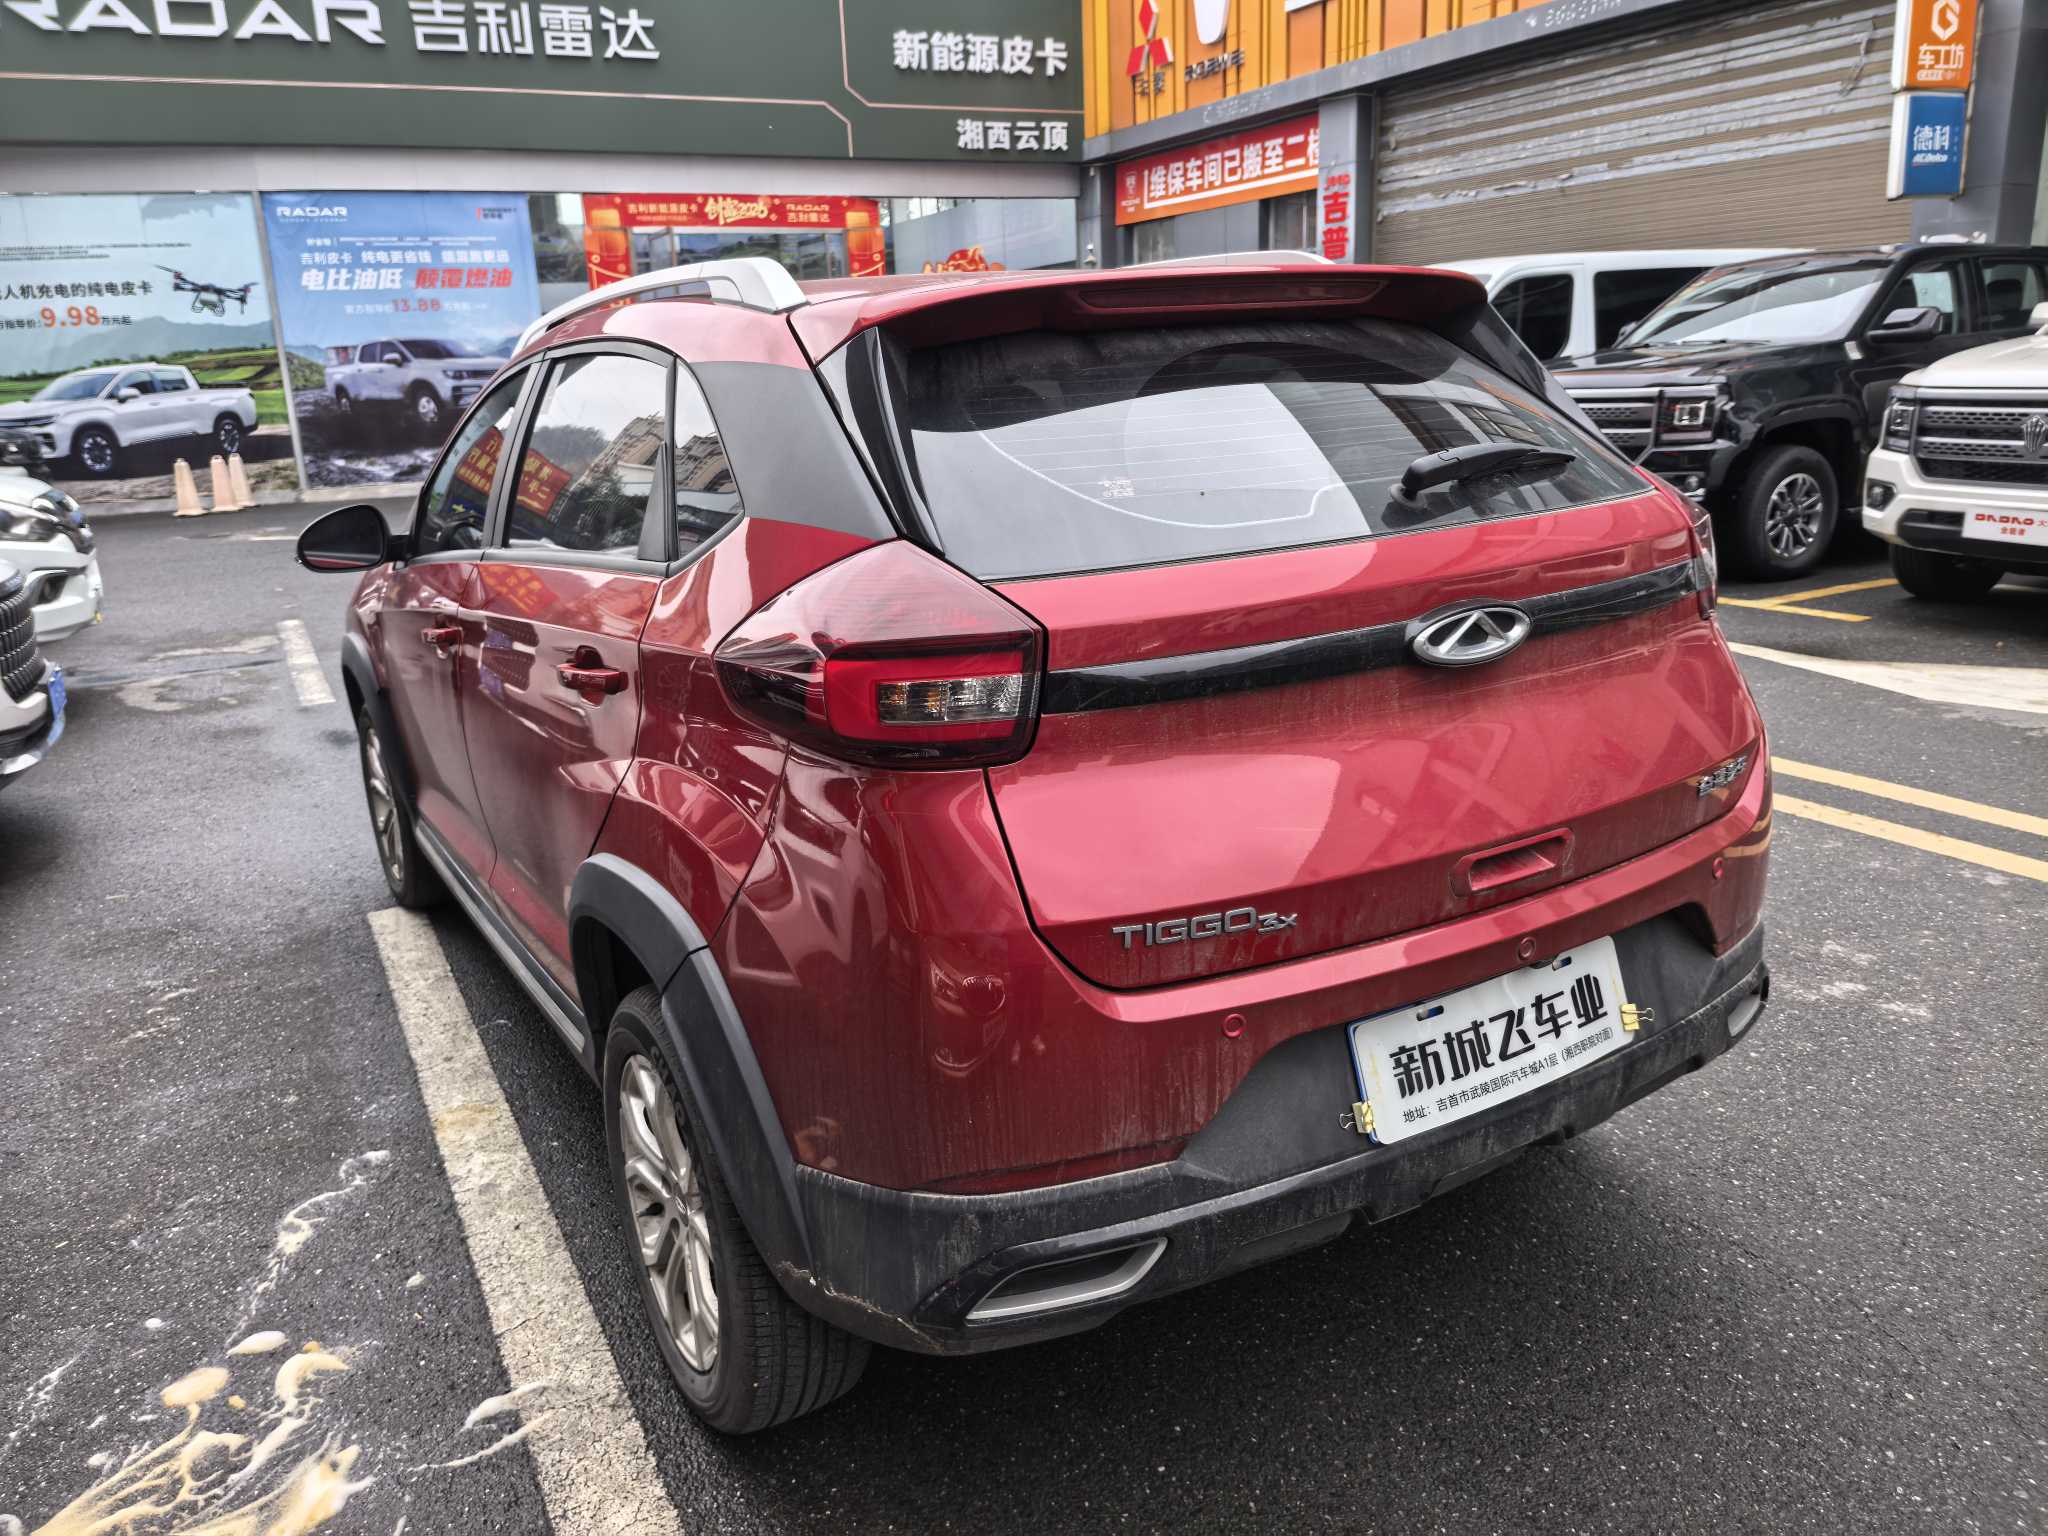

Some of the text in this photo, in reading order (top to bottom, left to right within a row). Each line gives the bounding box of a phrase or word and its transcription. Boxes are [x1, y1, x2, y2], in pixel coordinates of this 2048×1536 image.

[408, 0, 660, 61] 吉利雷达
[892, 29, 1069, 78] 新能源皮卡
[1917, 43, 1965, 69] 车工坊
[955, 118, 1070, 153] 湘西云顶
[1912, 124, 1951, 151] 德科
[276, 206, 348, 217] RADAR
[0, 281, 153, 300] 人机充电的纯电皮卡
[301, 268, 403, 291] 电比油低
[40, 306, 101, 328] 9.98
[1112, 906, 1257, 949] TIGGO
[1388, 973, 1609, 1099] 新城飞车业
